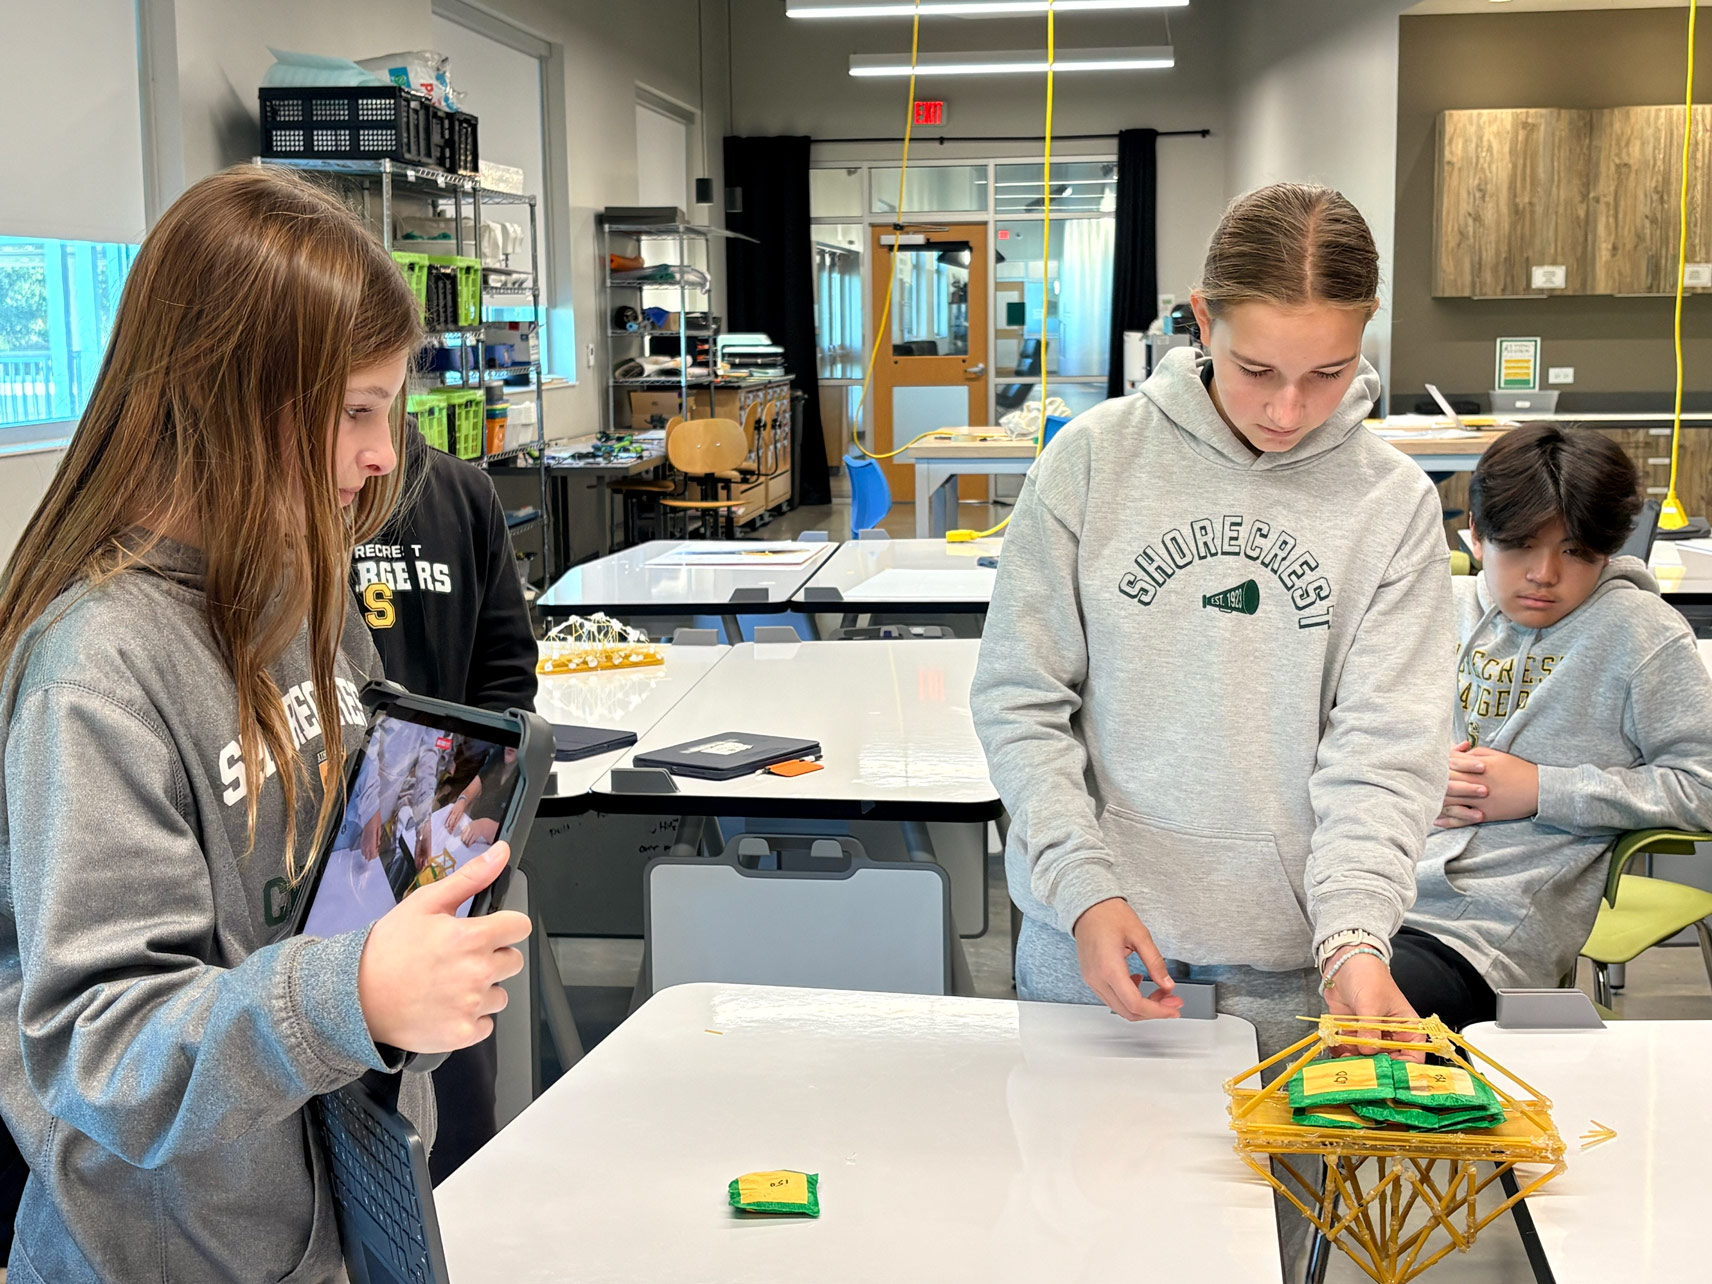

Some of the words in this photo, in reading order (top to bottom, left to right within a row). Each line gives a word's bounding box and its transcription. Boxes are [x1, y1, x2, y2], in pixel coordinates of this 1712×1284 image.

[914, 101, 945, 125] EXIT
[356, 560, 452, 593] RGERS
[1118, 515, 1335, 631] SHORECREST
[1211, 595, 1225, 606] EST.
